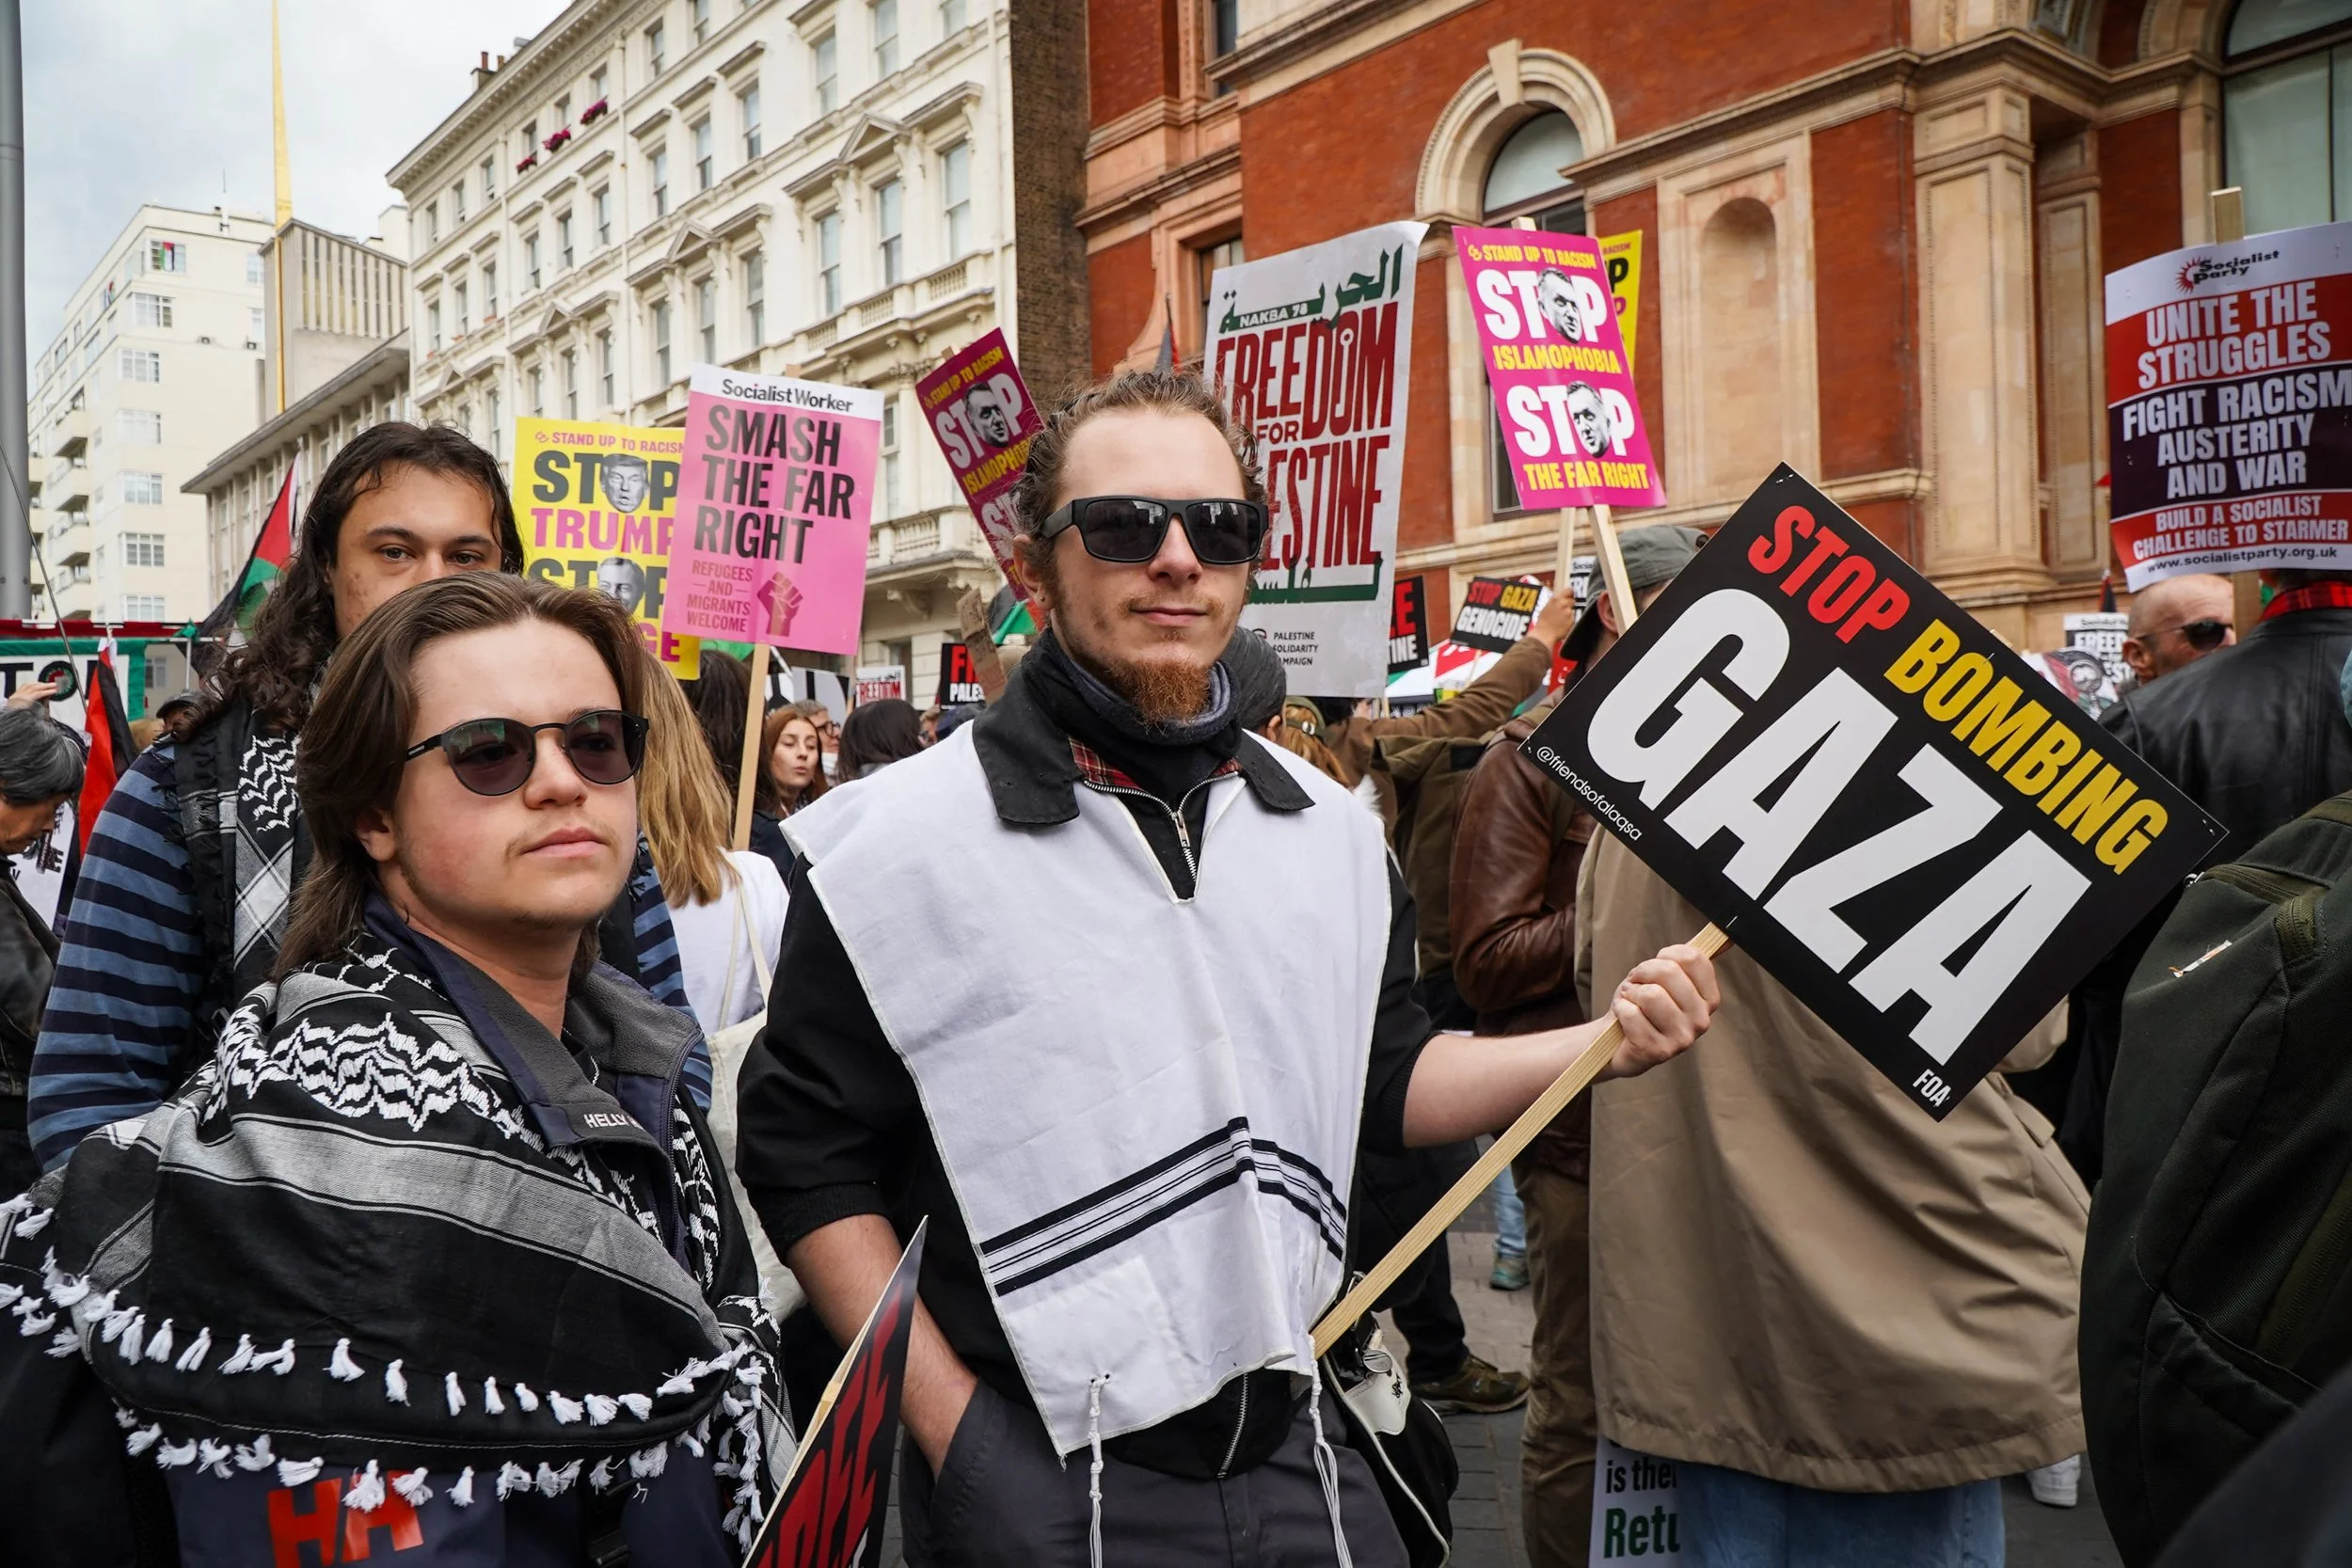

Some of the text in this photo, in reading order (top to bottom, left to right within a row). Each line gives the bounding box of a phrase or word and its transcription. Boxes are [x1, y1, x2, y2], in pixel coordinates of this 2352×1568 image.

[1482, 245, 1597, 270] STAND UP TO RACISM
[2198, 250, 2280, 273] Socialist
[1240, 309, 1289, 328] NAKBA
[1476, 268, 1607, 343] STP
[2146, 280, 2317, 348] UNITE THE
[1214, 301, 1398, 446] FREEDOM
[1493, 344, 1622, 374] ISLAMOPHOBIA
[2137, 321, 2331, 390] STRUGGLES
[935, 372, 1023, 469] STP
[1506, 383, 1635, 458] STP
[2122, 369, 2352, 442] FIGHT RACISM
[551, 432, 595, 447] STAND
[598, 435, 616, 448] UP
[621, 438, 636, 451] TO
[706, 404, 842, 467] SMASH
[1256, 420, 1300, 445] FOR
[2157, 413, 2315, 467] AUSTERITY
[532, 450, 680, 513] STP
[961, 436, 1032, 495] ISLAMOPHO
[1522, 461, 1650, 491] THE FAR RIGHT
[2167, 451, 2308, 500] AND WAR
[702, 453, 855, 520] THE FAR
[1260, 435, 1391, 571] ESTINE
[694, 504, 814, 564] RIGHT
[2155, 496, 2322, 533] BUILD A SOCIALIST
[2133, 519, 2349, 561] CHALLENGE TO STARMER
[2147, 546, 2338, 574] www.socialistparty.org.uk
[692, 560, 754, 583] REFUGEES
[707, 579, 733, 596] AND
[686, 594, 752, 616] MIGRANTS
[1468, 580, 1502, 606] STOP
[1500, 585, 1539, 613] GAZA
[687, 610, 747, 633] WELCOME
[1273, 631, 1315, 641] PALESTINE
[1456, 605, 1531, 641] GENOCIDE
[1279, 657, 1313, 666] MPAIGN
[1747, 505, 2169, 876] STOP BOMBING
[1536, 746, 1643, 841] @friendsofalaqsa
[1587, 588, 2093, 1067] GAZA
[1913, 1069, 1951, 1107] FOA
[583, 1113, 629, 1129] HELLY
[1606, 1459, 1628, 1494] is
[1604, 1505, 1680, 1559] Ret
